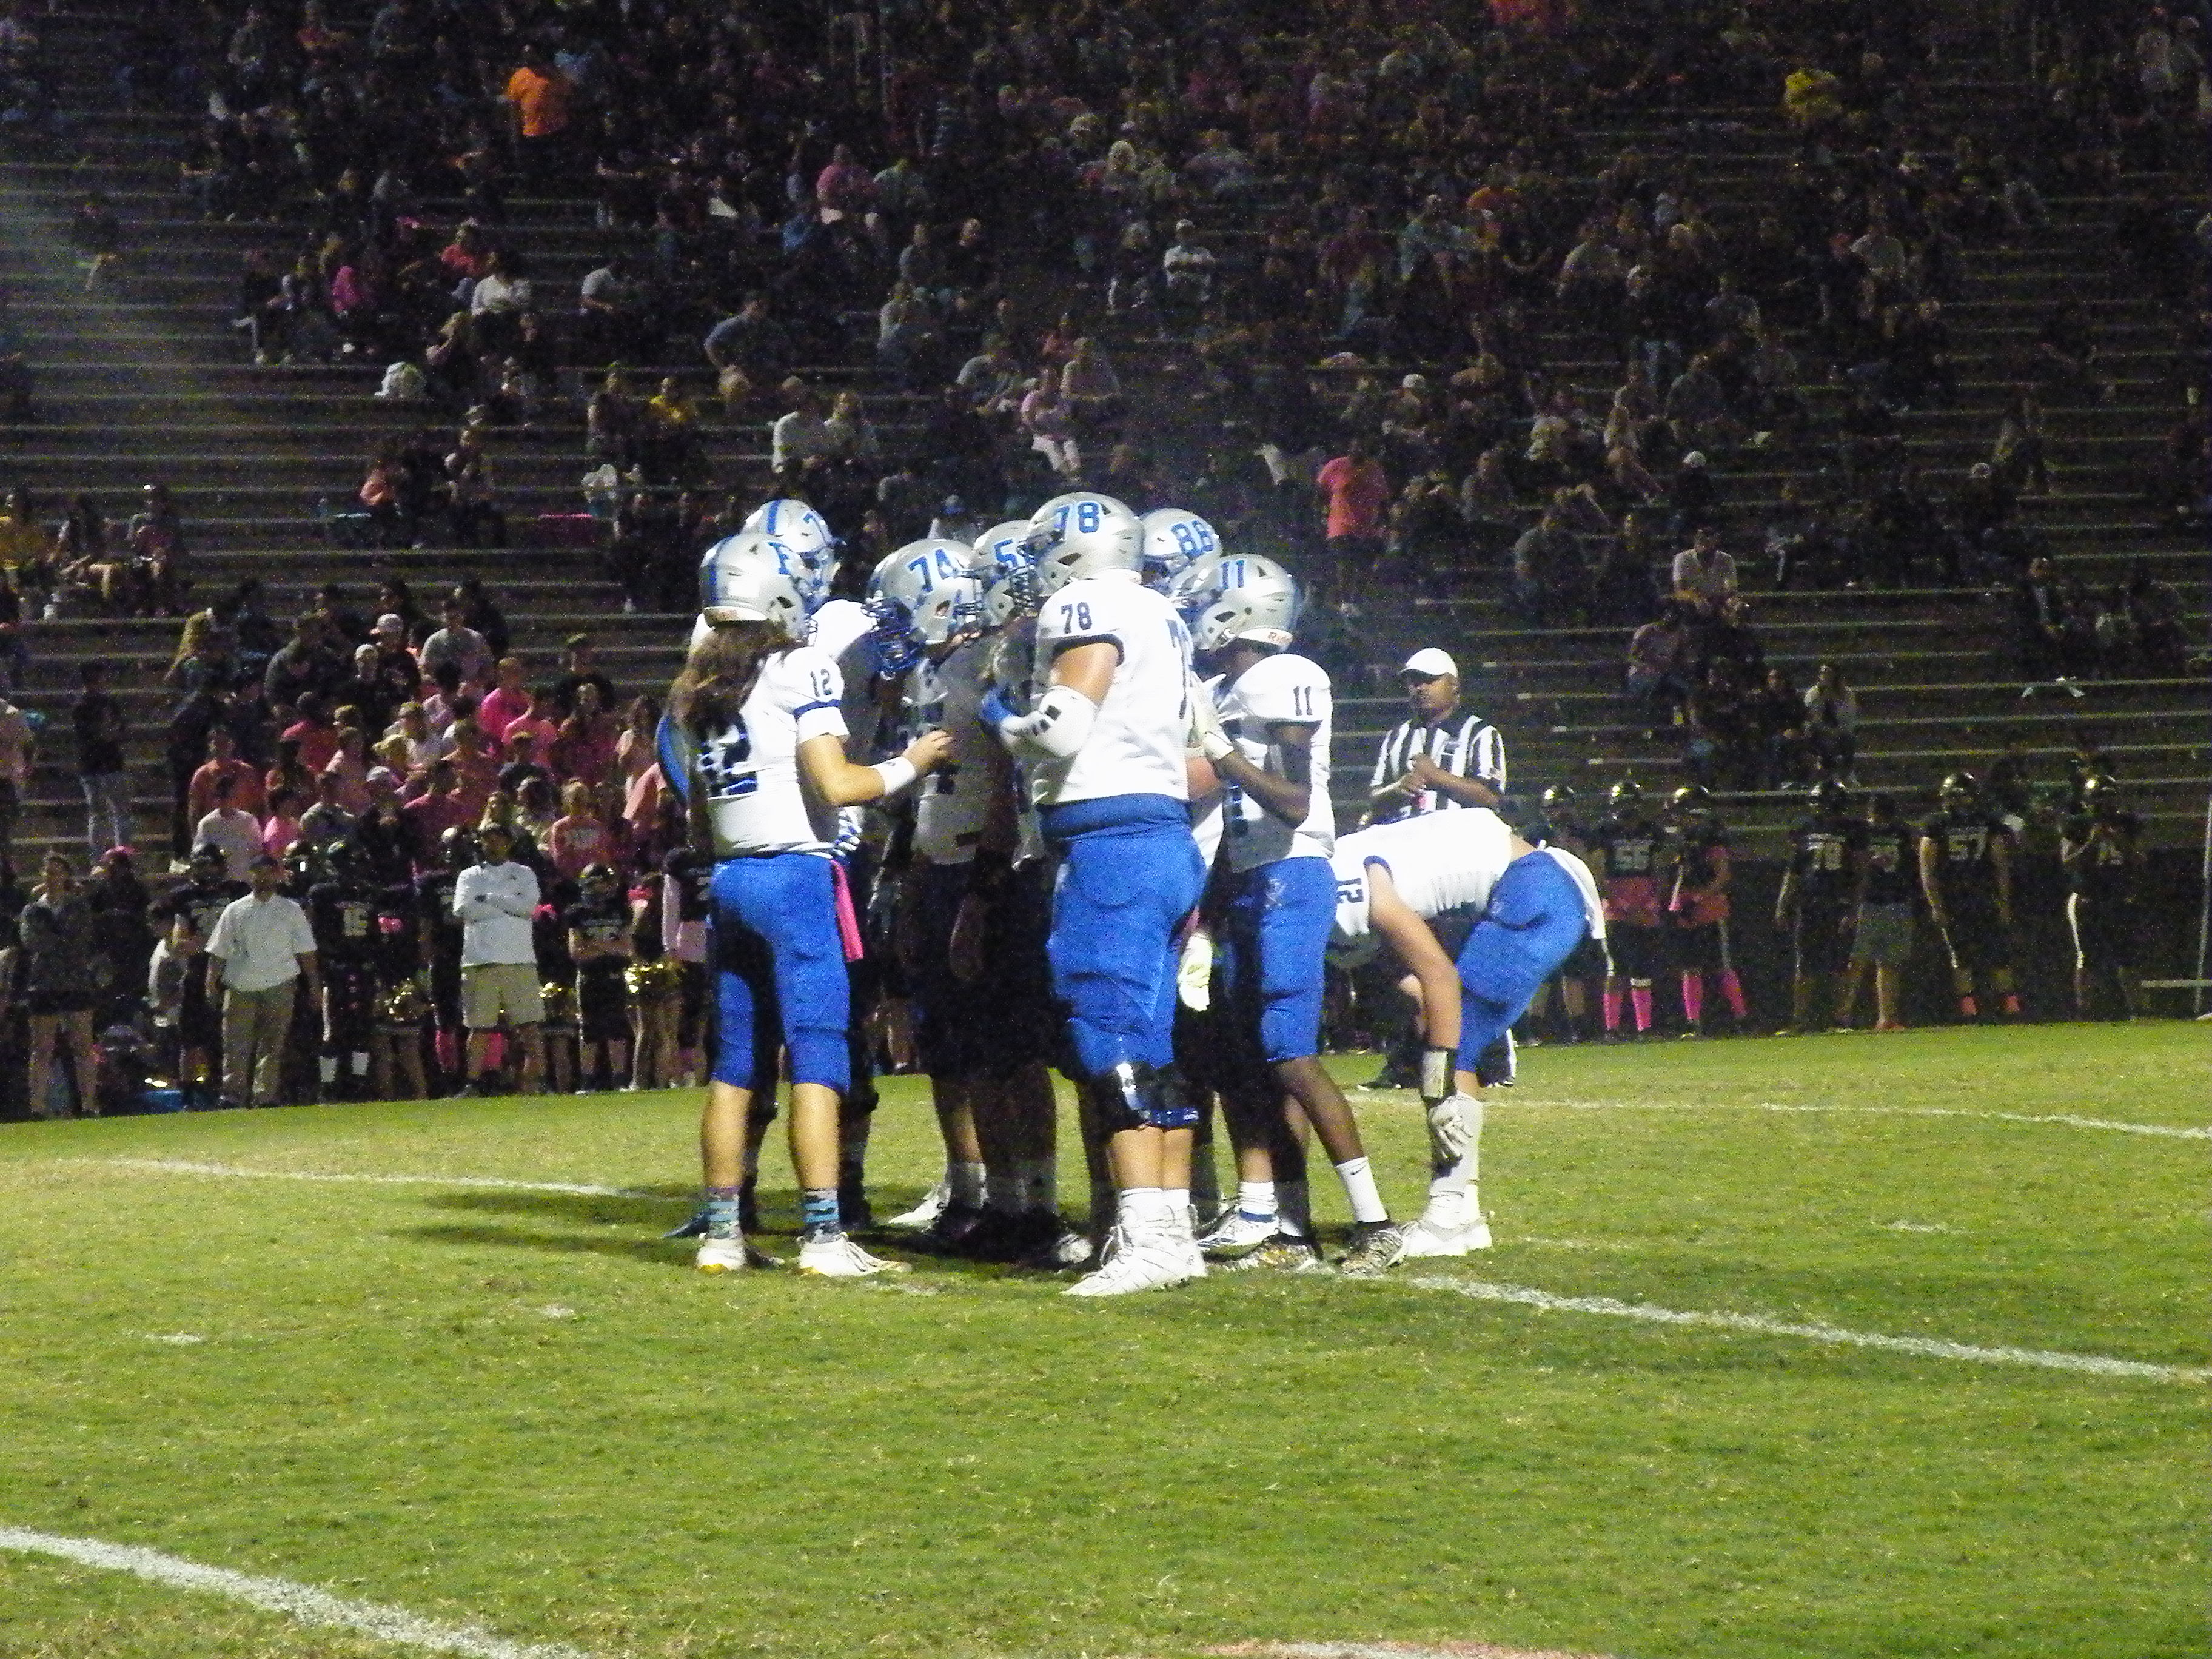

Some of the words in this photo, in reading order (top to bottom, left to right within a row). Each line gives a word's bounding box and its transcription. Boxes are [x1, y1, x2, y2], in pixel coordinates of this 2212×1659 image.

[1054, 502, 1099, 533] 78
[908, 549, 956, 592] 74
[1221, 560, 1244, 589] 11
[1061, 602, 1092, 633] 78
[809, 669, 832, 697] 12
[1293, 686, 1313, 716] 11
